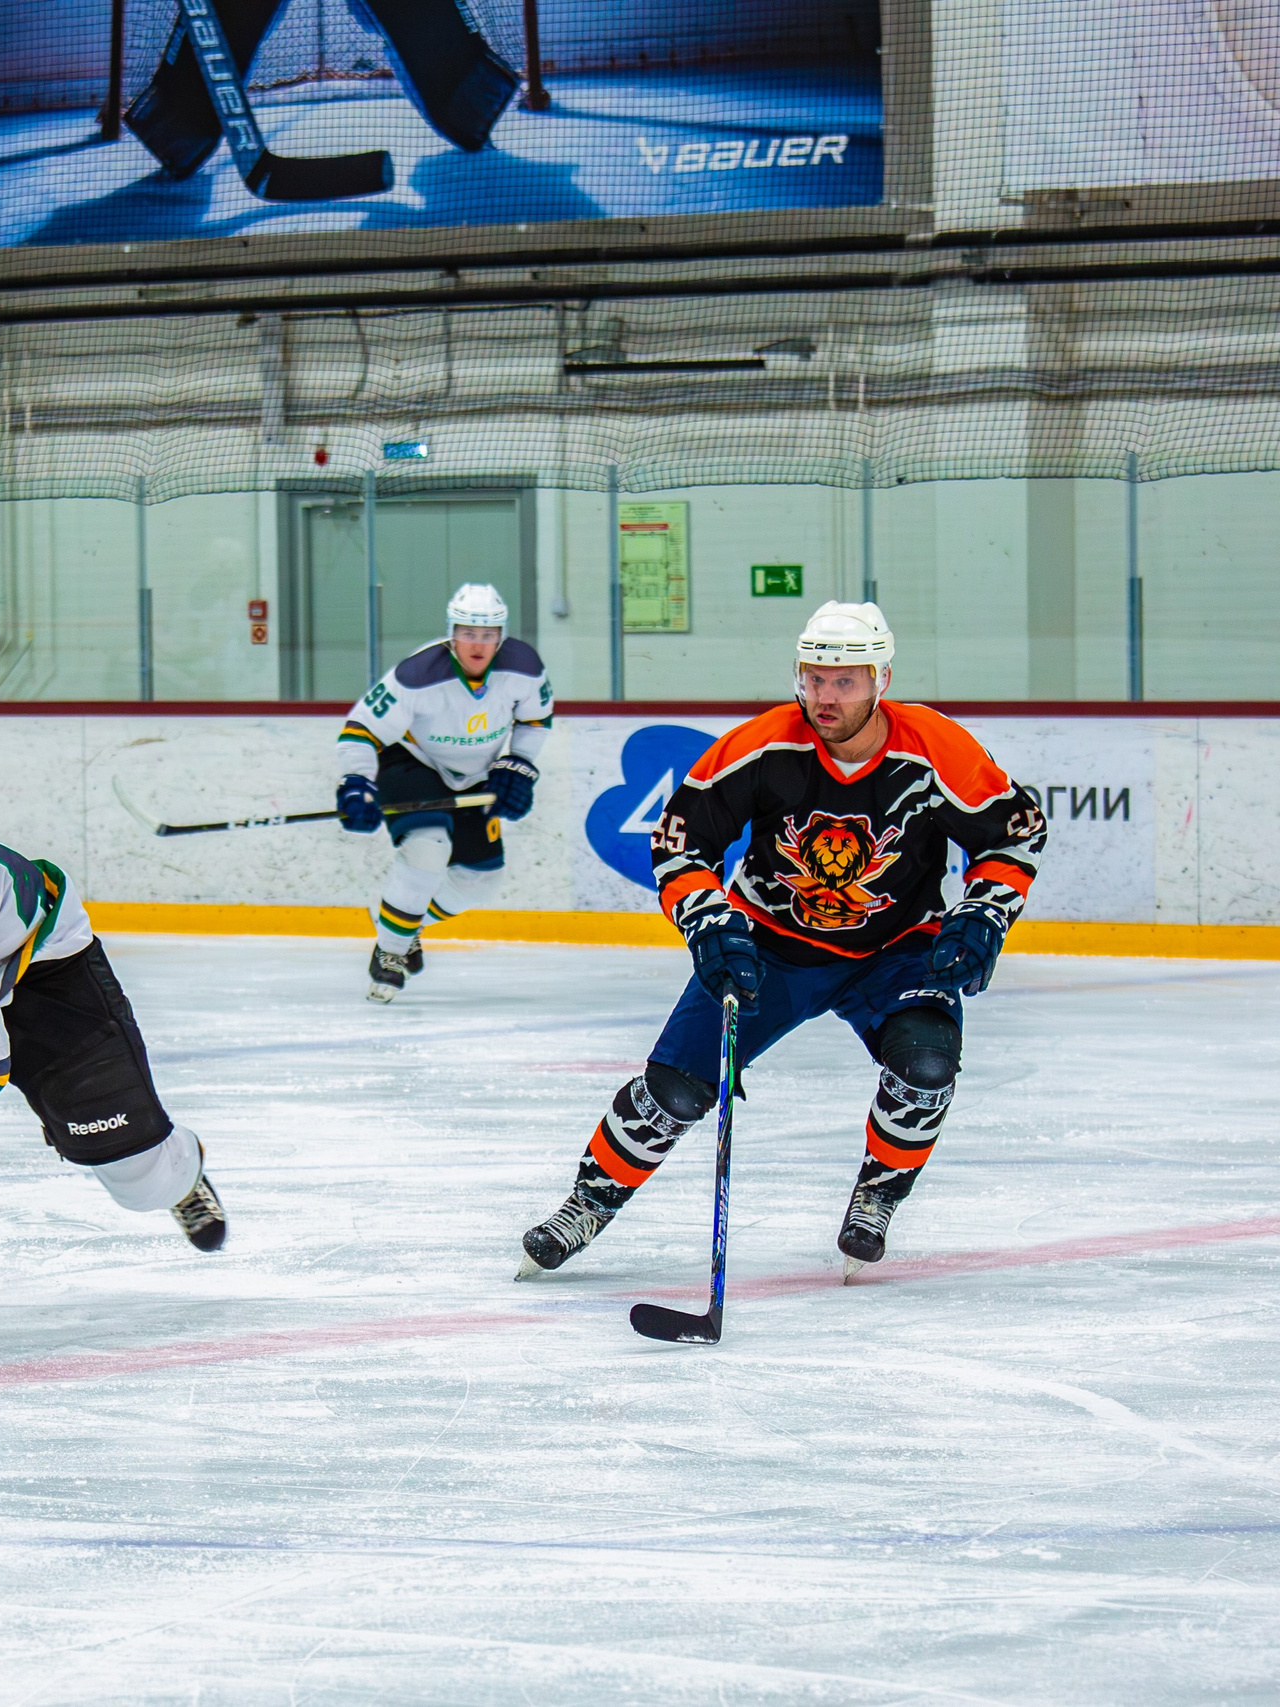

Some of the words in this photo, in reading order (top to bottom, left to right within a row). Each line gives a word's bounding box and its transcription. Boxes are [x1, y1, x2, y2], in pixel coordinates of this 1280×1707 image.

[674, 135, 849, 173] BAUER
[363, 682, 398, 719] 95
[899, 989, 956, 1006] CCM
[67, 1113, 129, 1136] Reebok
